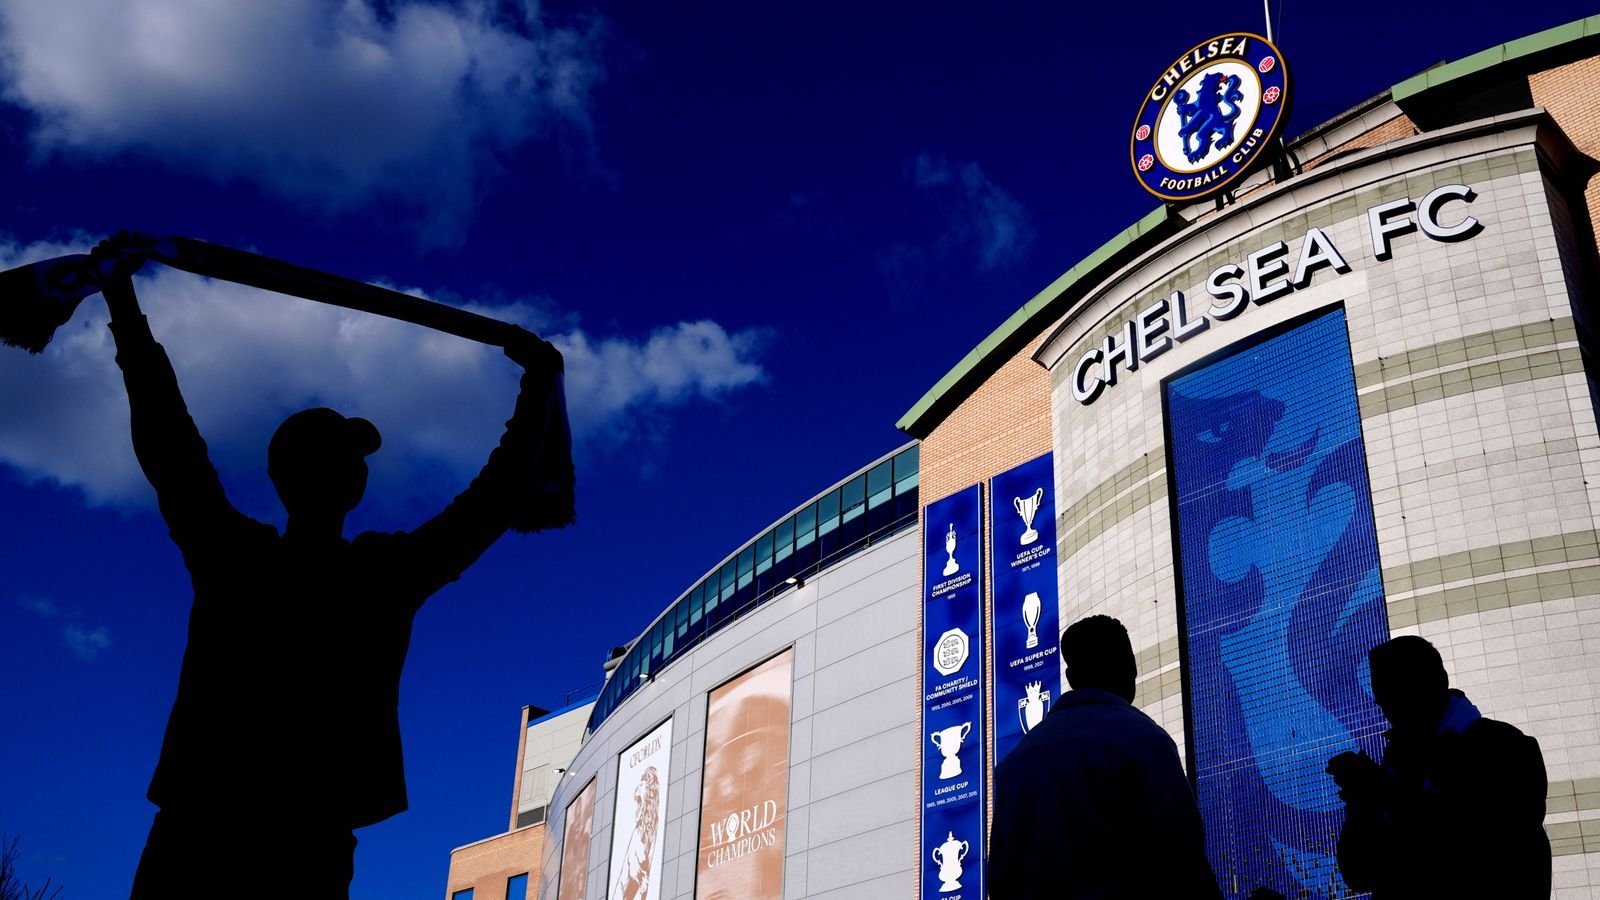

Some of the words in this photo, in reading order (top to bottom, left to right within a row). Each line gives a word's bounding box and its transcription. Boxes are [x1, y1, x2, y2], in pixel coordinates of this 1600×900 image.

[1151, 37, 1247, 101] CHELSEA
[1160, 165, 1228, 190] FOOTBALL
[1232, 128, 1264, 163] CLUB
[1071, 226, 1351, 405] CHELSEA
[1367, 184, 1484, 261] FC
[1010, 553, 1039, 568] WINNER'S
[1038, 547, 1051, 557] CUP
[1016, 549, 1031, 560] UEFA
[1030, 545, 1044, 554] CUP
[931, 578, 972, 598] CHAMPIONSHIP
[932, 581, 948, 592] FIRST
[947, 573, 971, 587] DIVISION
[1009, 657, 1025, 668] UEFA
[1024, 651, 1044, 663] SUPER
[1044, 646, 1057, 656] CUP
[926, 686, 959, 701] COMMUNITY
[958, 679, 978, 692] SHIELD
[935, 683, 943, 692] FA
[943, 677, 966, 690] CHARITY
[934, 784, 956, 796] LEAGUE
[956, 781, 969, 791] CUP
[710, 800, 777, 847] WORLD
[707, 828, 776, 868] CHAMPIONS
